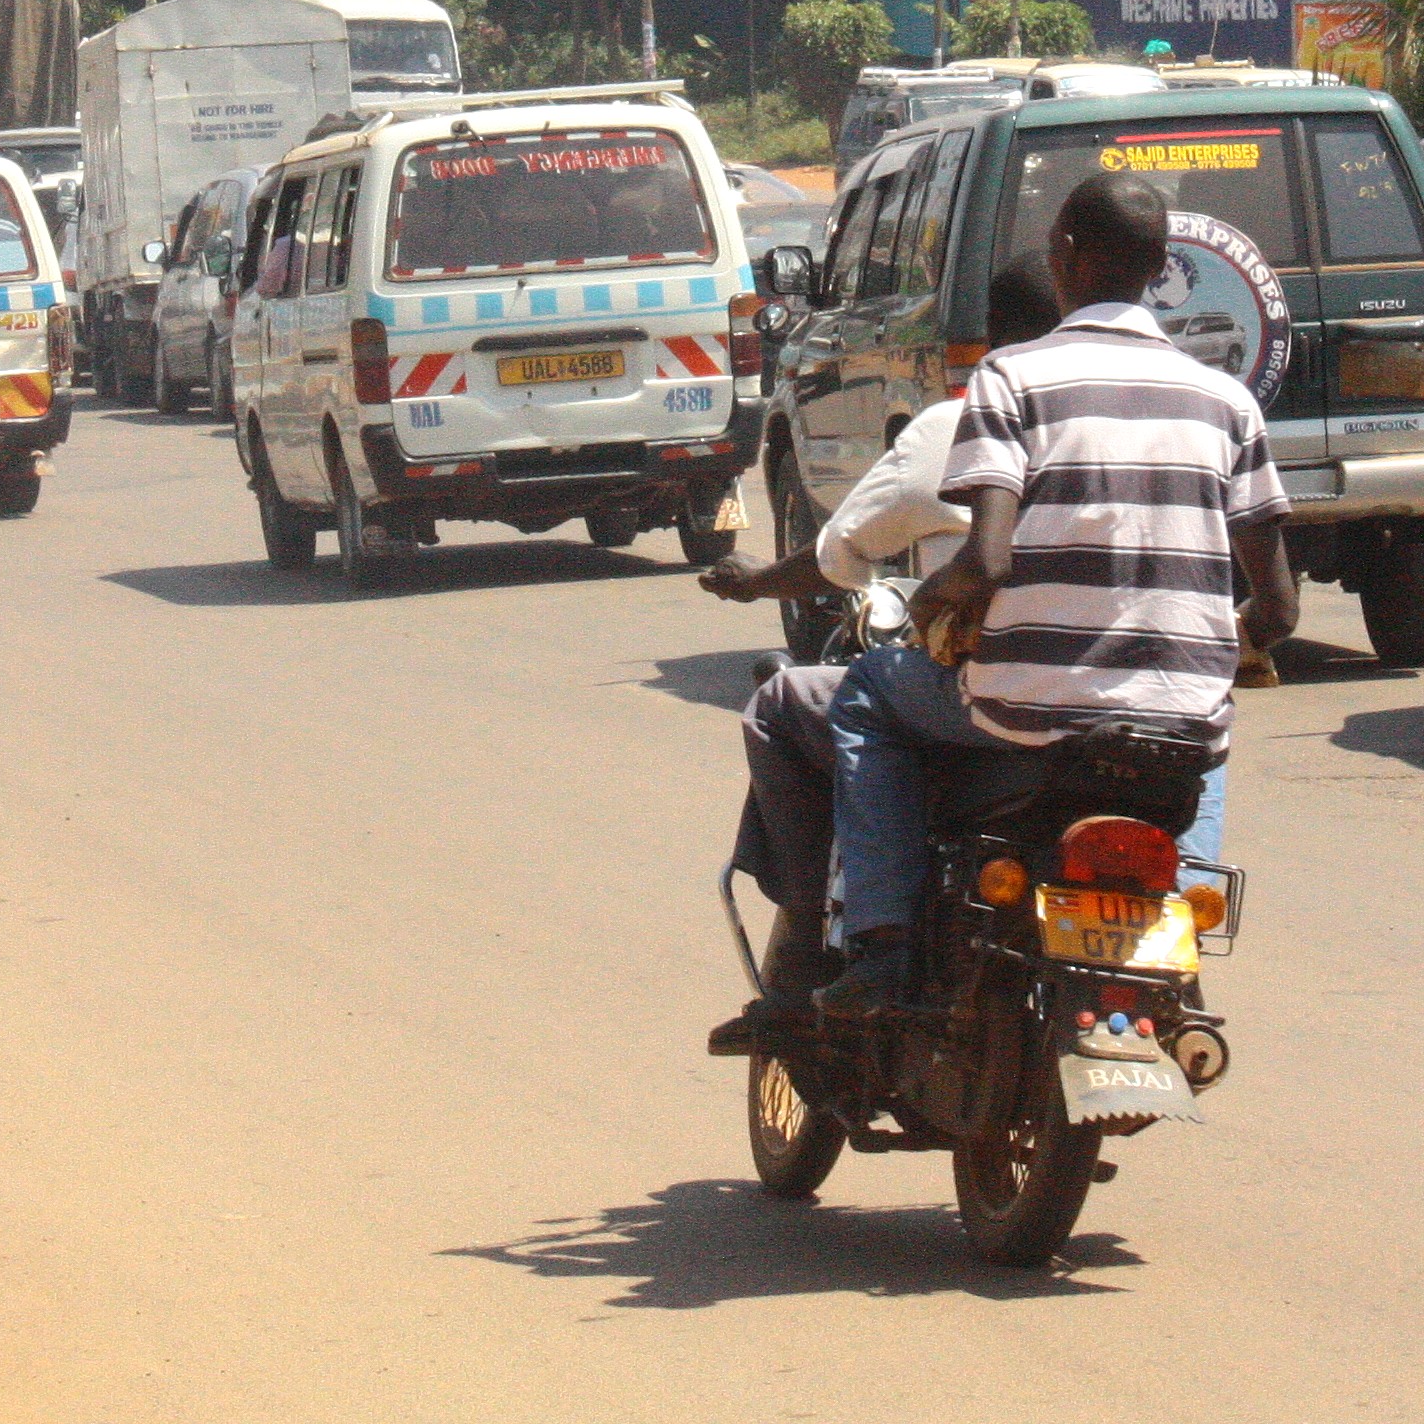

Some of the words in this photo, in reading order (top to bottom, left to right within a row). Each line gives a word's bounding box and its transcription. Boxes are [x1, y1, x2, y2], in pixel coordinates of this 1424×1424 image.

[198, 106, 219, 117] NOT
[1126, 146, 1165, 162] SAJID
[1168, 144, 1259, 161] ENTERPRISES
[1168, 215, 1285, 320] ERPRISES
[1360, 299, 1405, 311] ISUZU
[522, 359, 557, 380] UAL
[1257, 339, 1286, 399] 499508
[663, 387, 713, 412] 458B
[409, 403, 445, 428] UAL
[1344, 419, 1420, 434] BIGHORN
[1087, 1069, 1174, 1091] BAJAJ
